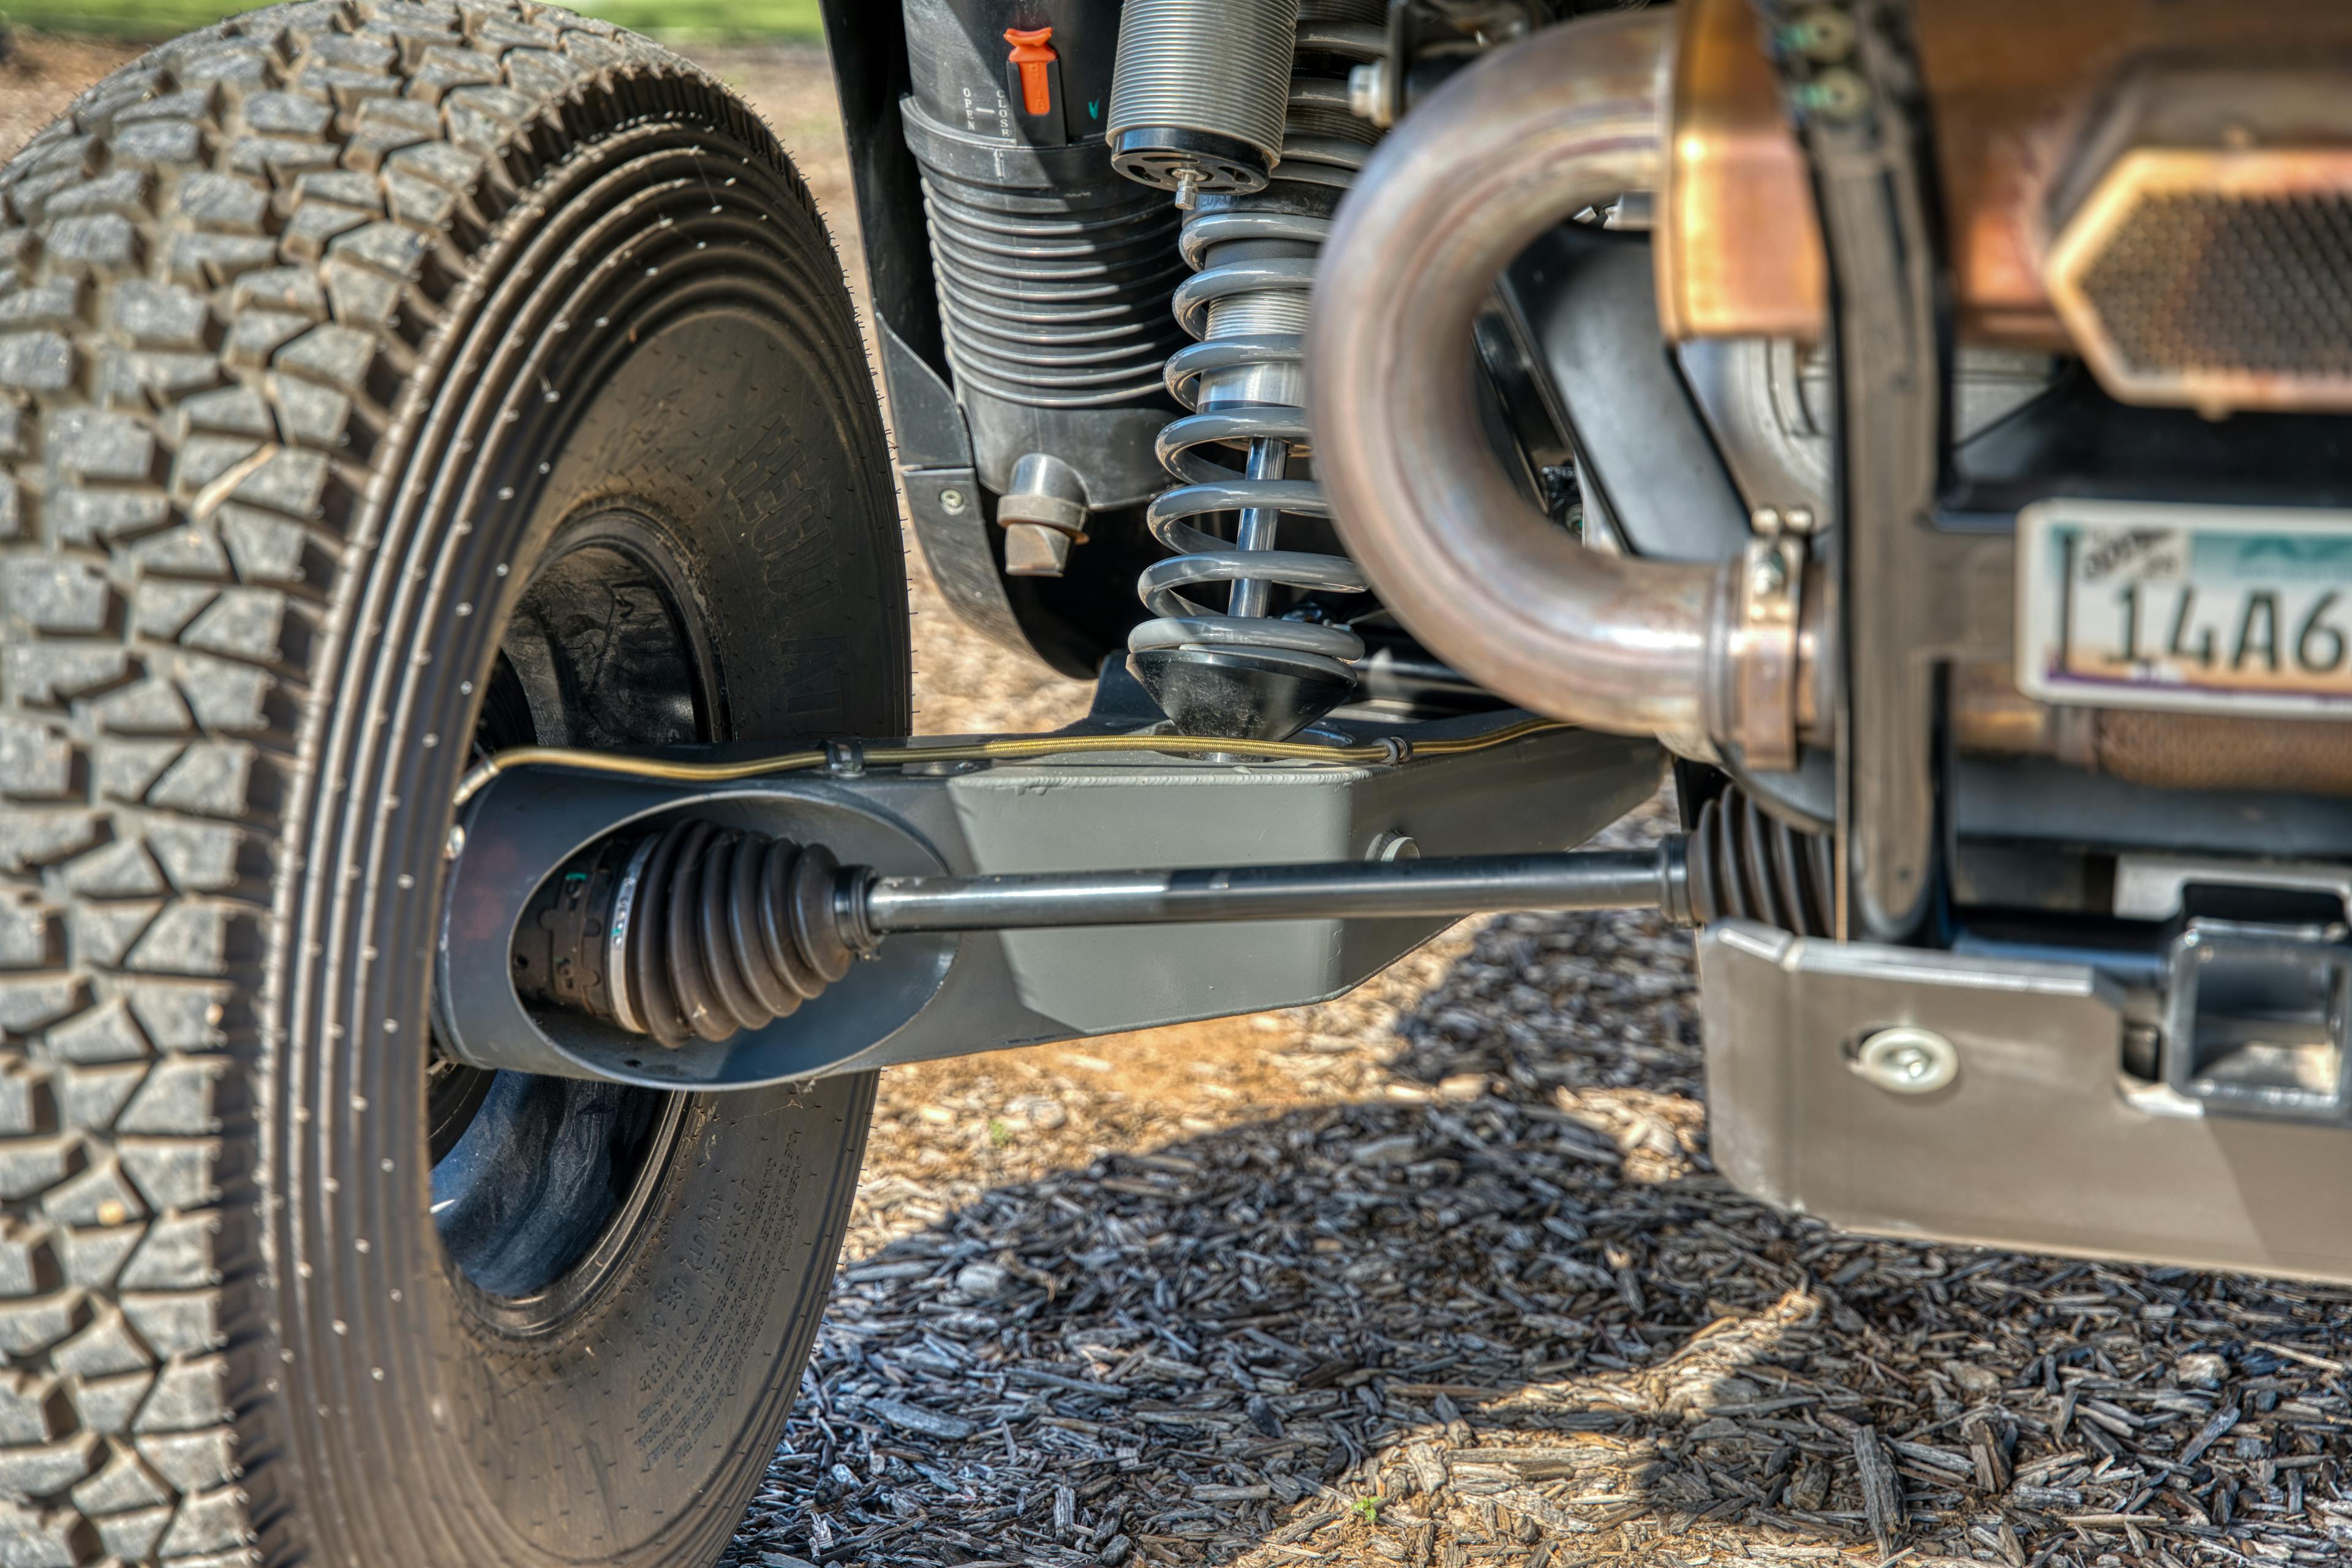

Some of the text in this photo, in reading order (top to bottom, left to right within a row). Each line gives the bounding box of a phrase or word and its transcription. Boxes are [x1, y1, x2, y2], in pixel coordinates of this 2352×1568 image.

[963, 87, 975, 130] OPEN
[2101, 582, 2346, 673] 14A6
[660, 1275, 690, 1312] USE
